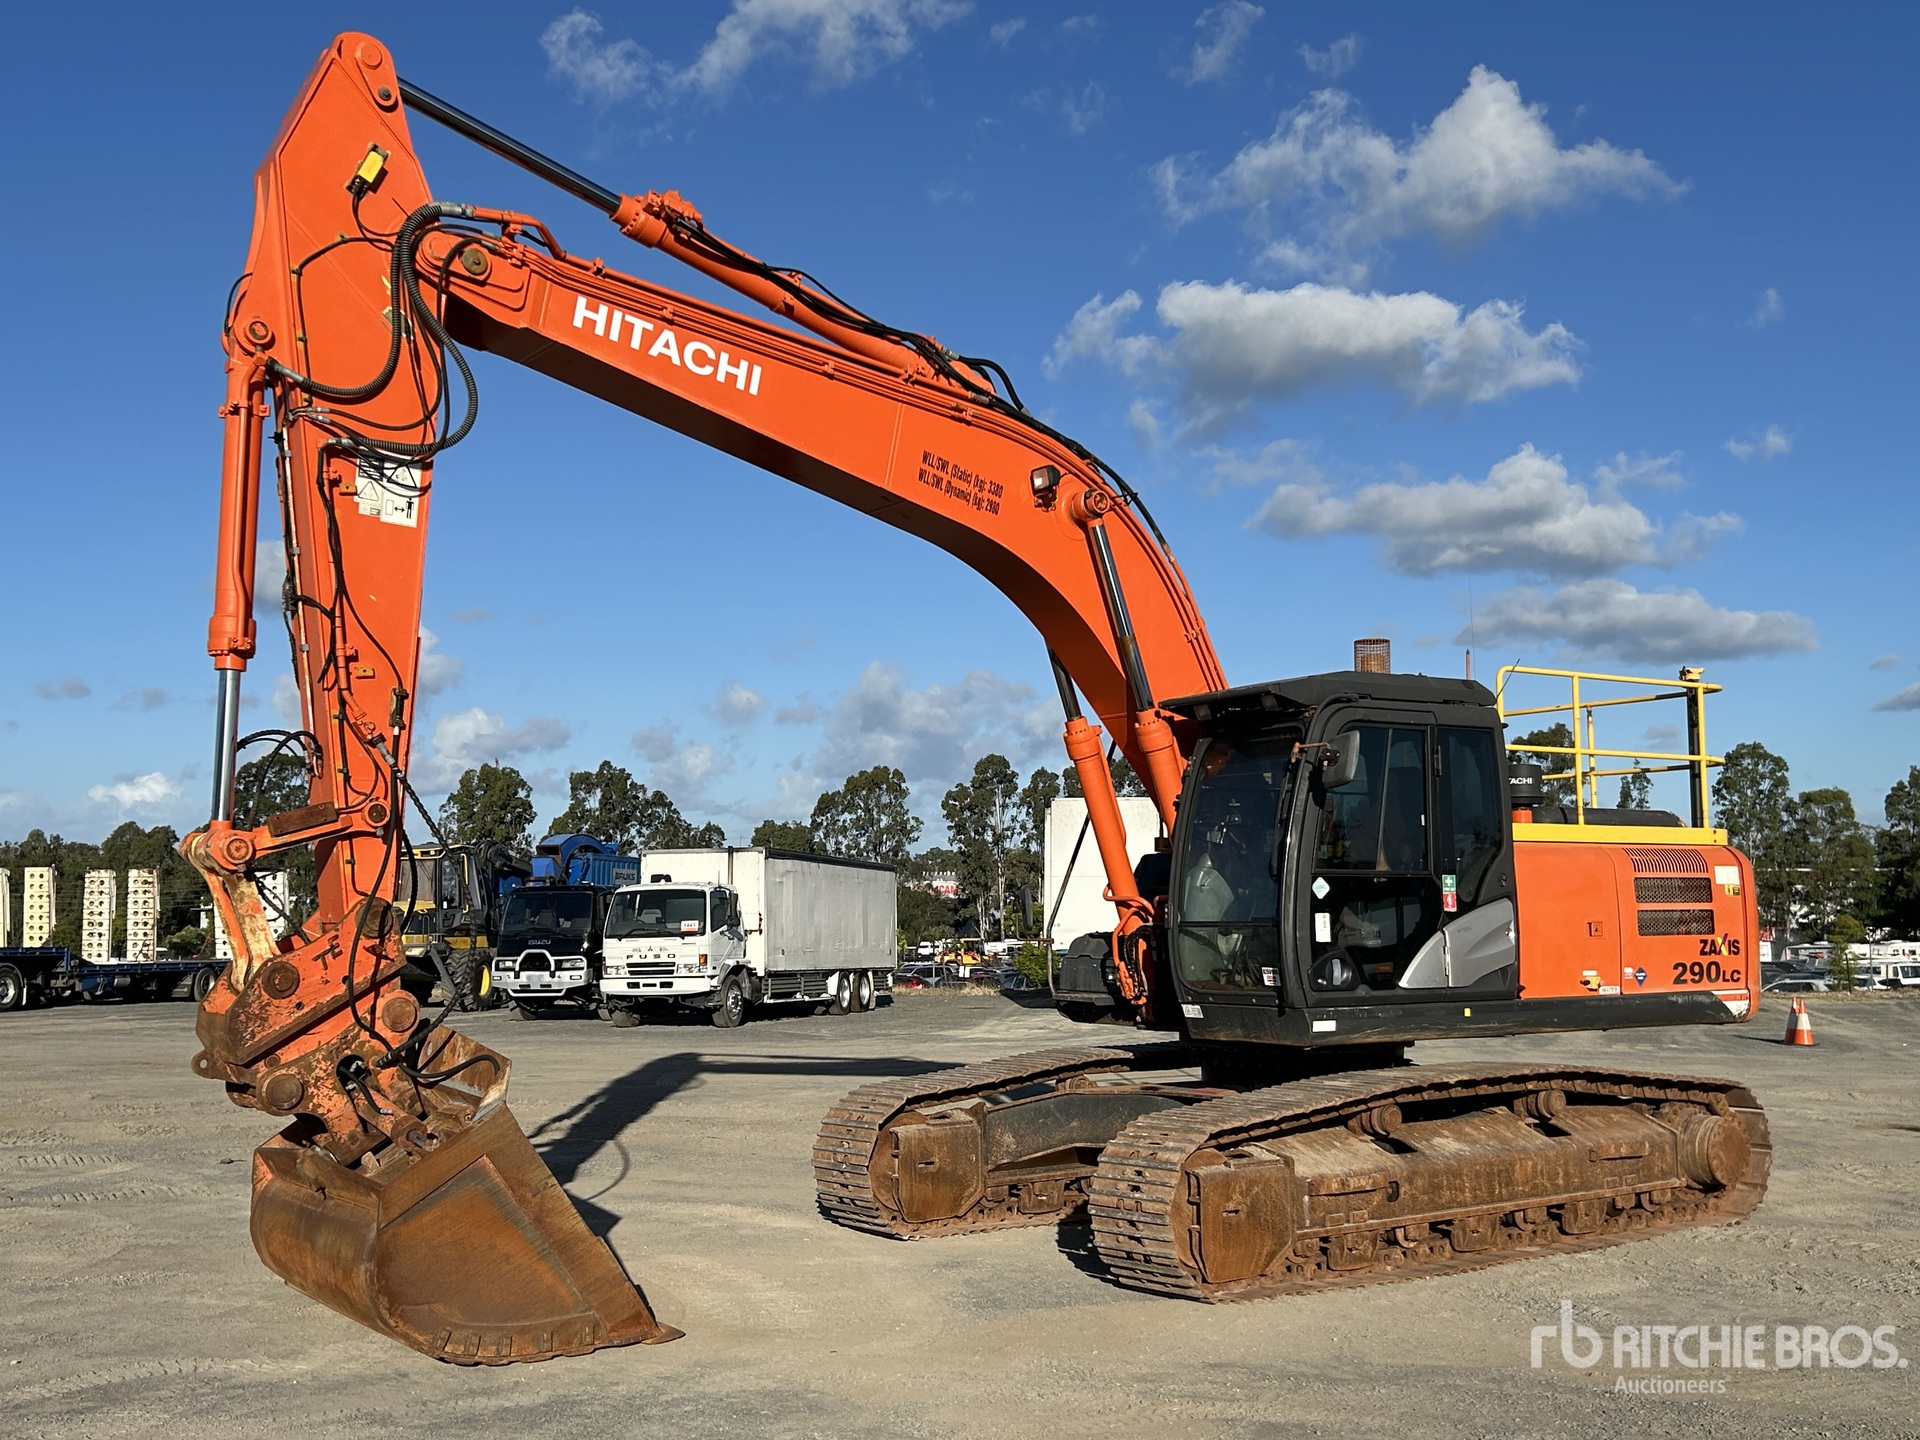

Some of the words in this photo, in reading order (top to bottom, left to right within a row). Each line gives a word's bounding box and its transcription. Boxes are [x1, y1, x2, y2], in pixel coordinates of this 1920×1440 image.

[572, 295, 762, 396] HITACHI
[950, 463, 973, 487] (Static)
[973, 474, 987, 493] (kg):
[944, 480, 972, 506] (Dynamic)
[971, 491, 985, 512] (kg):
[1699, 933, 1740, 956] ZAXIS
